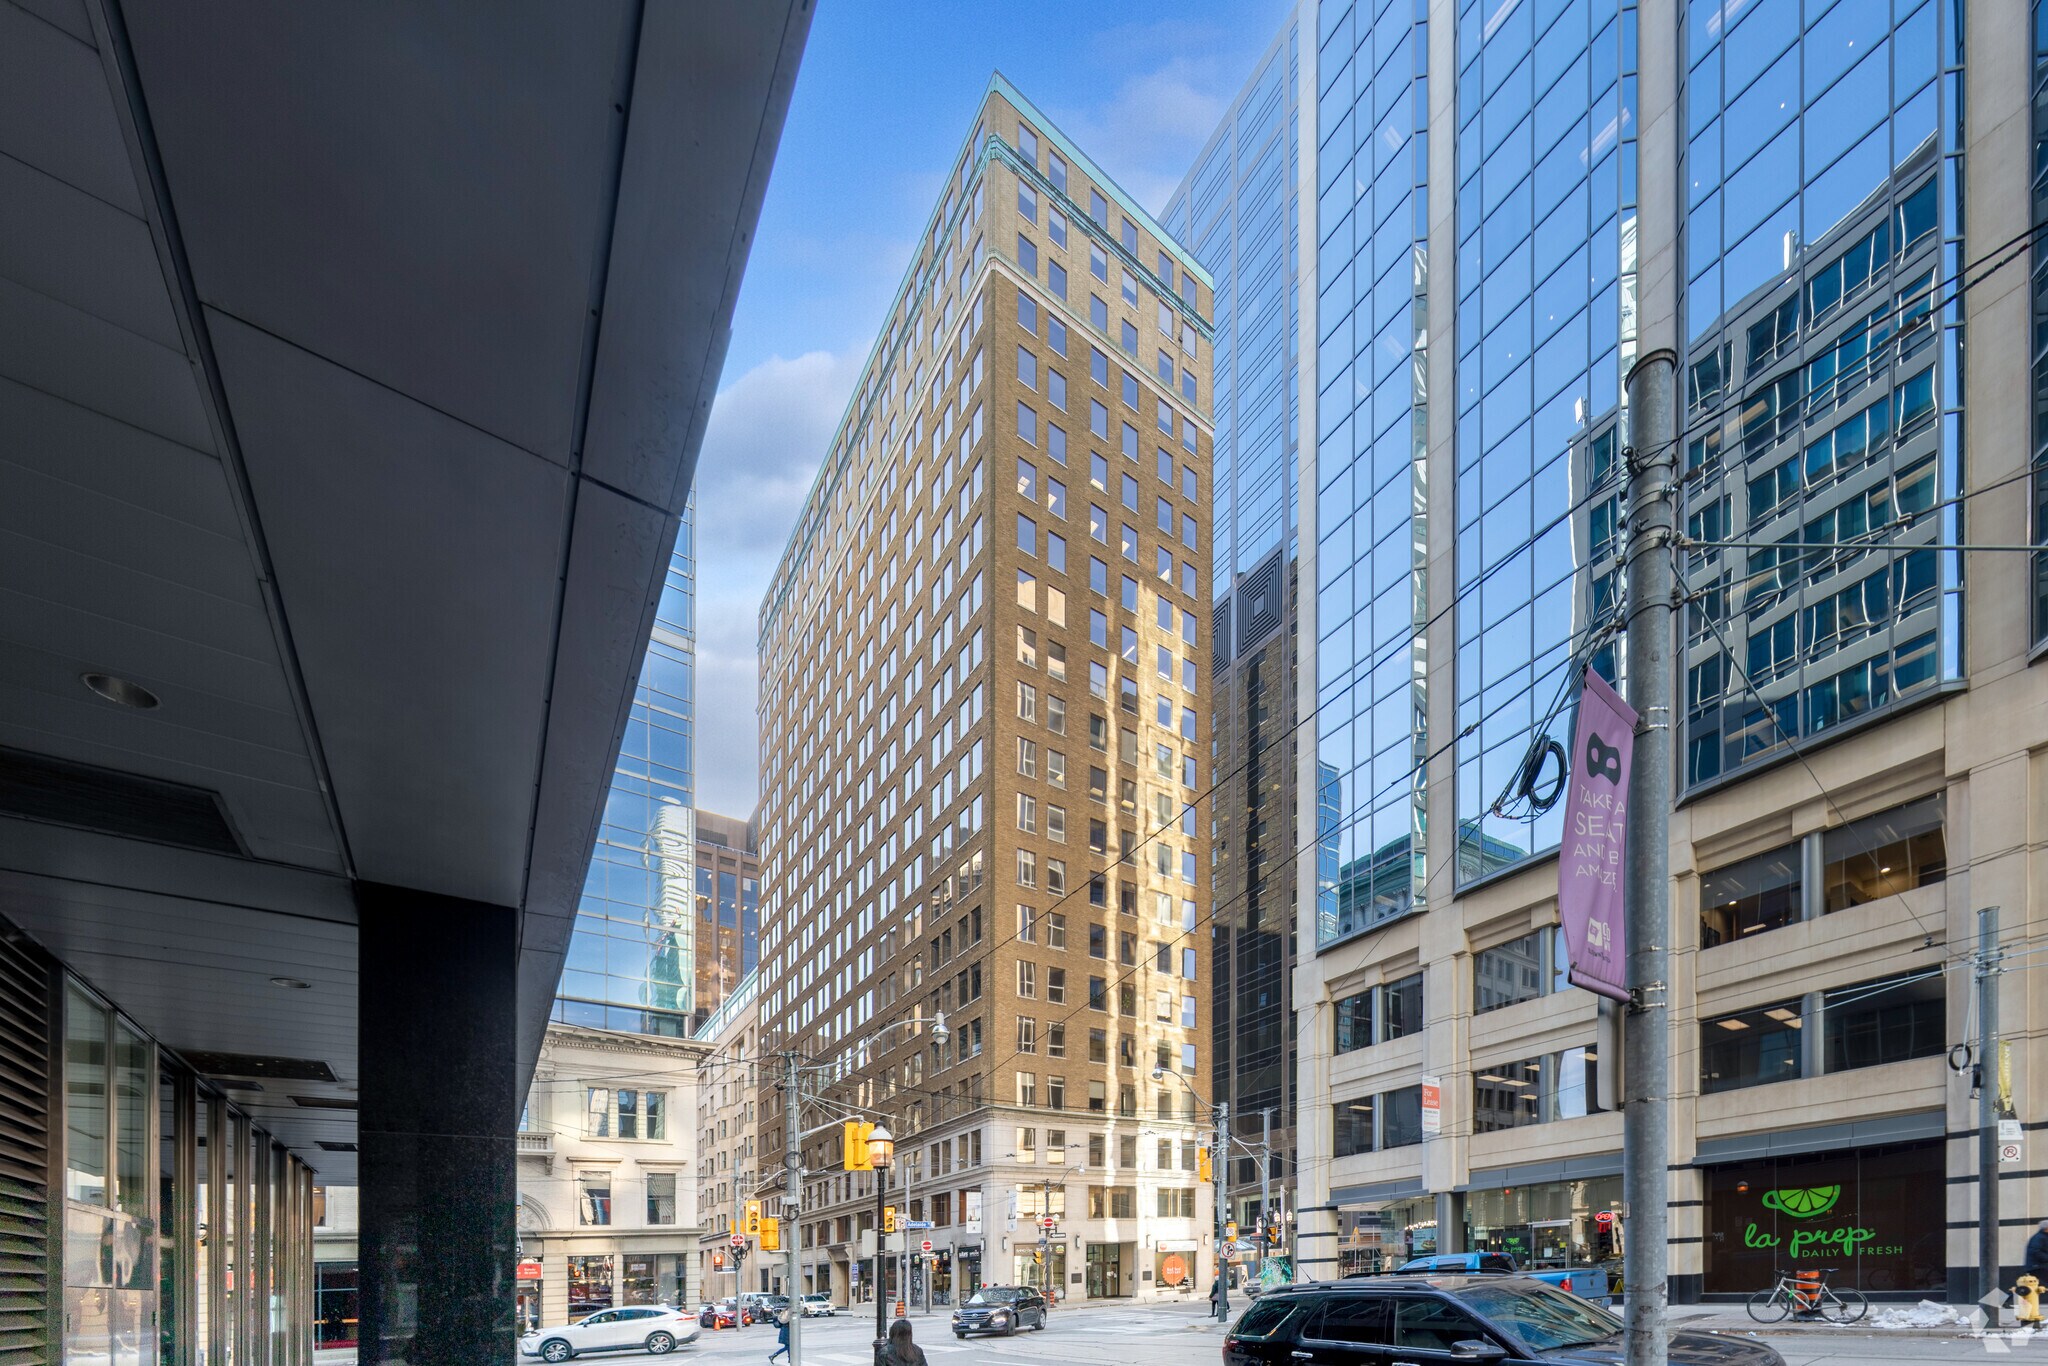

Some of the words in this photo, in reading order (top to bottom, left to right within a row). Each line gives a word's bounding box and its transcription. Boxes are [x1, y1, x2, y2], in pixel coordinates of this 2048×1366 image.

[1580, 784, 1613, 810] TAKE
[1614, 801, 1625, 815] A
[1574, 811, 1624, 844] SEAT
[1424, 1088, 1433, 1097] For
[1424, 1097, 1439, 1107] Lease
[907, 1221, 927, 1229] Adelaide
[1744, 1223, 1781, 1249] la
[1789, 1226, 1877, 1259] prep
[1802, 1248, 1840, 1258] DAILY
[1859, 1245, 1903, 1256] FRESH
